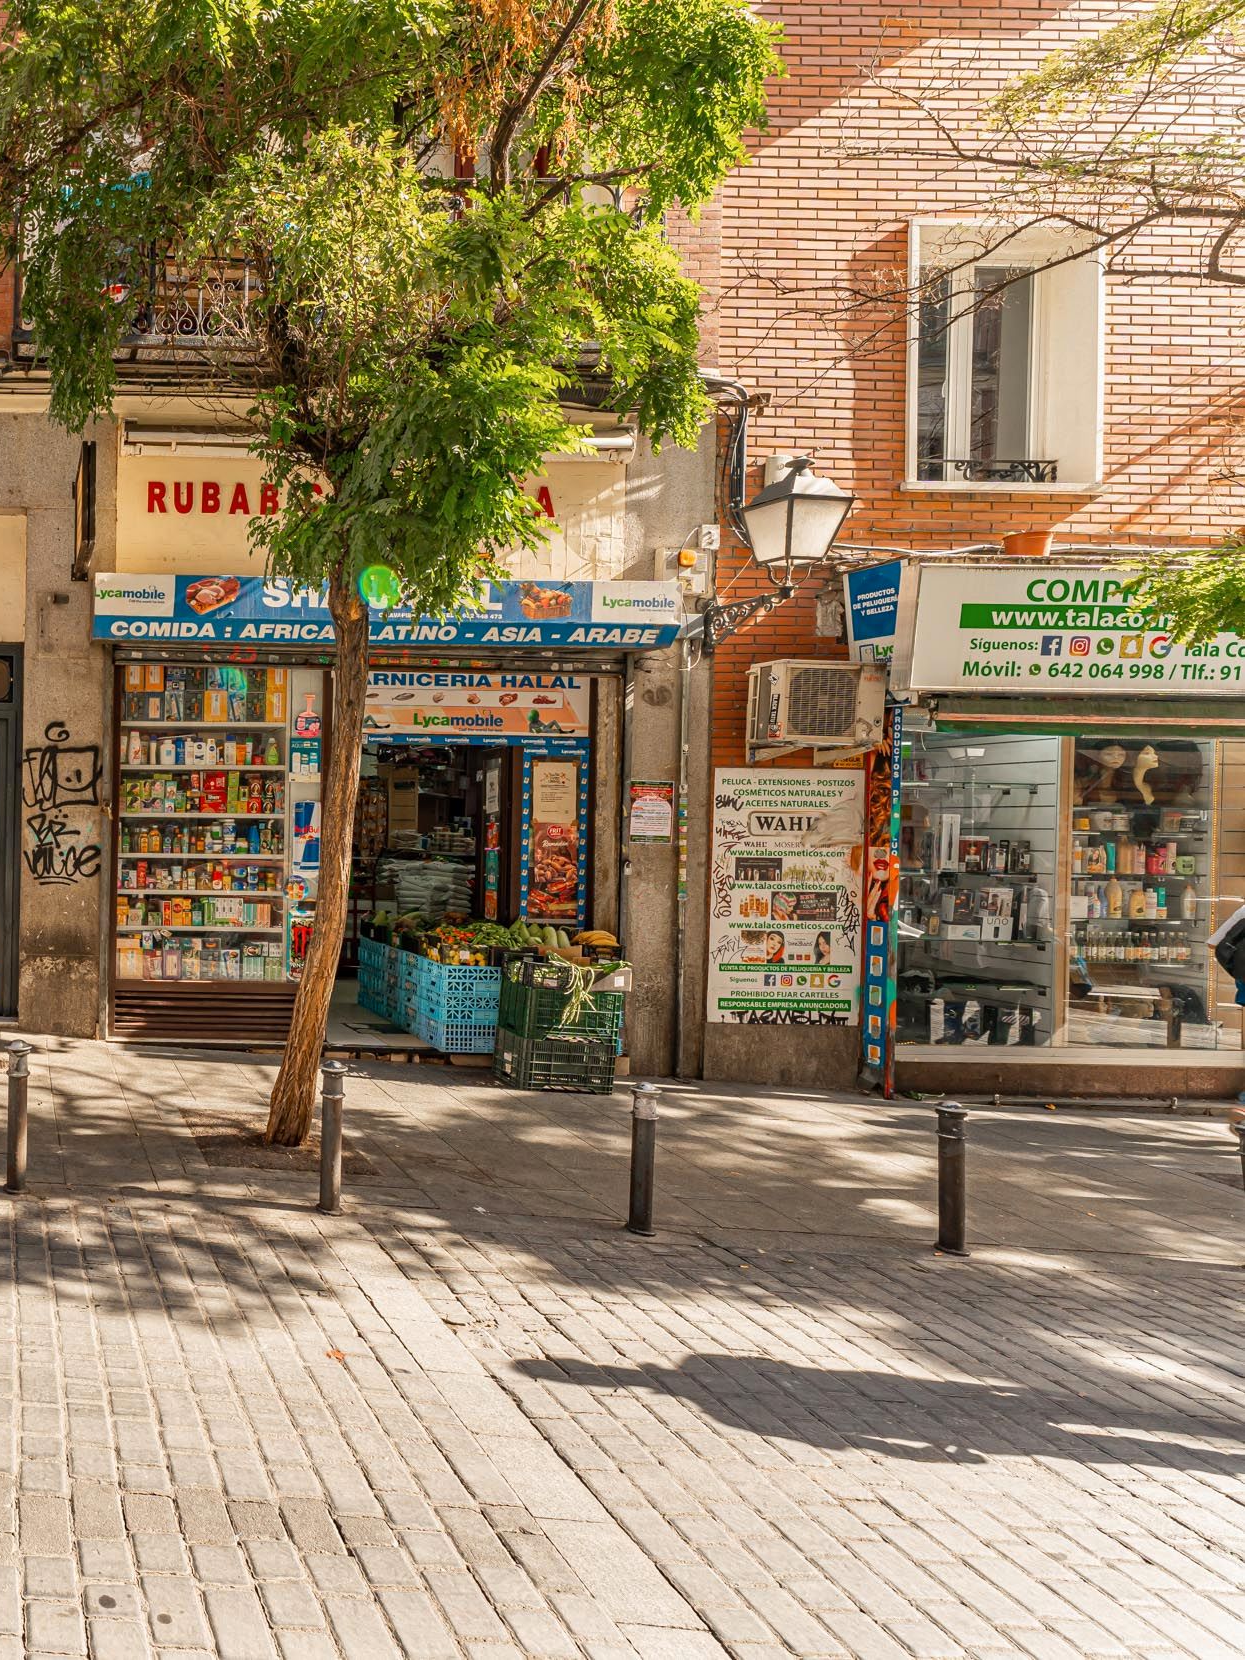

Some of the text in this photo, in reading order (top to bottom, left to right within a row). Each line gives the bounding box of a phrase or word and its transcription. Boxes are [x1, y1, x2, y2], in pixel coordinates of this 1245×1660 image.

[857, 588, 895, 601] PRODUCTOS
[602, 594, 675, 609] Lycamobile
[866, 605, 895, 616] BELLEZA
[110, 620, 216, 638] COMIDA
[482, 626, 542, 642] ASIA
[567, 627, 660, 644] ARABE
[970, 636, 1039, 652] Síguenos:
[962, 660, 1021, 677] Móvil:
[1048, 662, 1084, 678] 642
[1088, 662, 1124, 679] 064
[1129, 663, 1164, 680] 998
[1220, 665, 1241, 681] 91
[500, 675, 581, 689] HALAL
[413, 711, 504, 729] Lycamobile
[722, 778, 856, 787] PELUCA EXTENSIONES POSTIZOS
[733, 787, 787, 797] COSMÉTICOS
[788, 789, 837, 798] NATURALES
[745, 799, 832, 809] ACEITES NATURALES.
[729, 849, 845, 858] www.talacosmeticos.com
[728, 921, 845, 931] www.talacosmeticos.com
[730, 990, 775, 998] PROHIBIDO
[720, 1001, 767, 1009] RESPONSABLE
[799, 1002, 849, 1010] ANUNCIADORA
